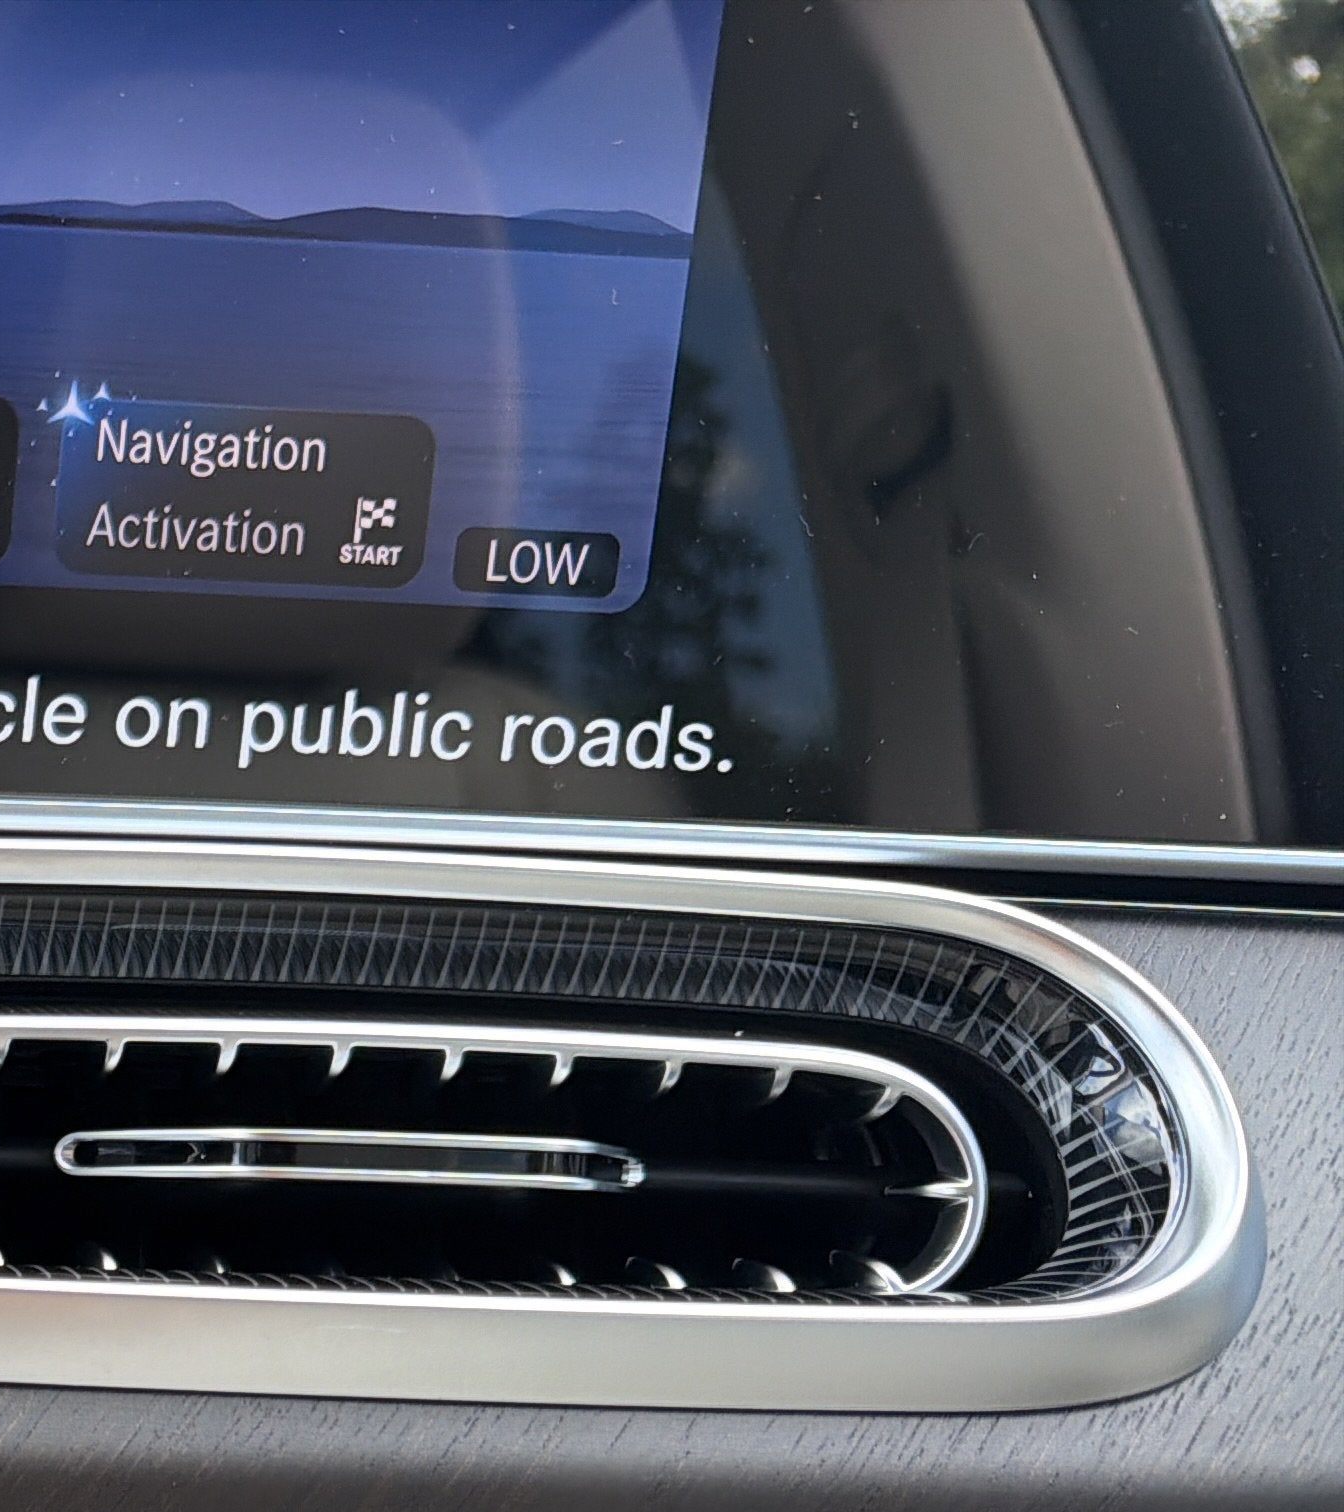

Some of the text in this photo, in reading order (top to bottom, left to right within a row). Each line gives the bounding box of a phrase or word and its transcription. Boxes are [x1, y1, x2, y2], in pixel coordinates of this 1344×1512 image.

[97, 418, 326, 478] Navigation
[86, 503, 304, 556] Activation
[339, 543, 403, 566] START
[486, 539, 590, 586] LOW
[115, 698, 209, 749] on
[238, 690, 472, 769] public
[500, 705, 733, 773] roads.
